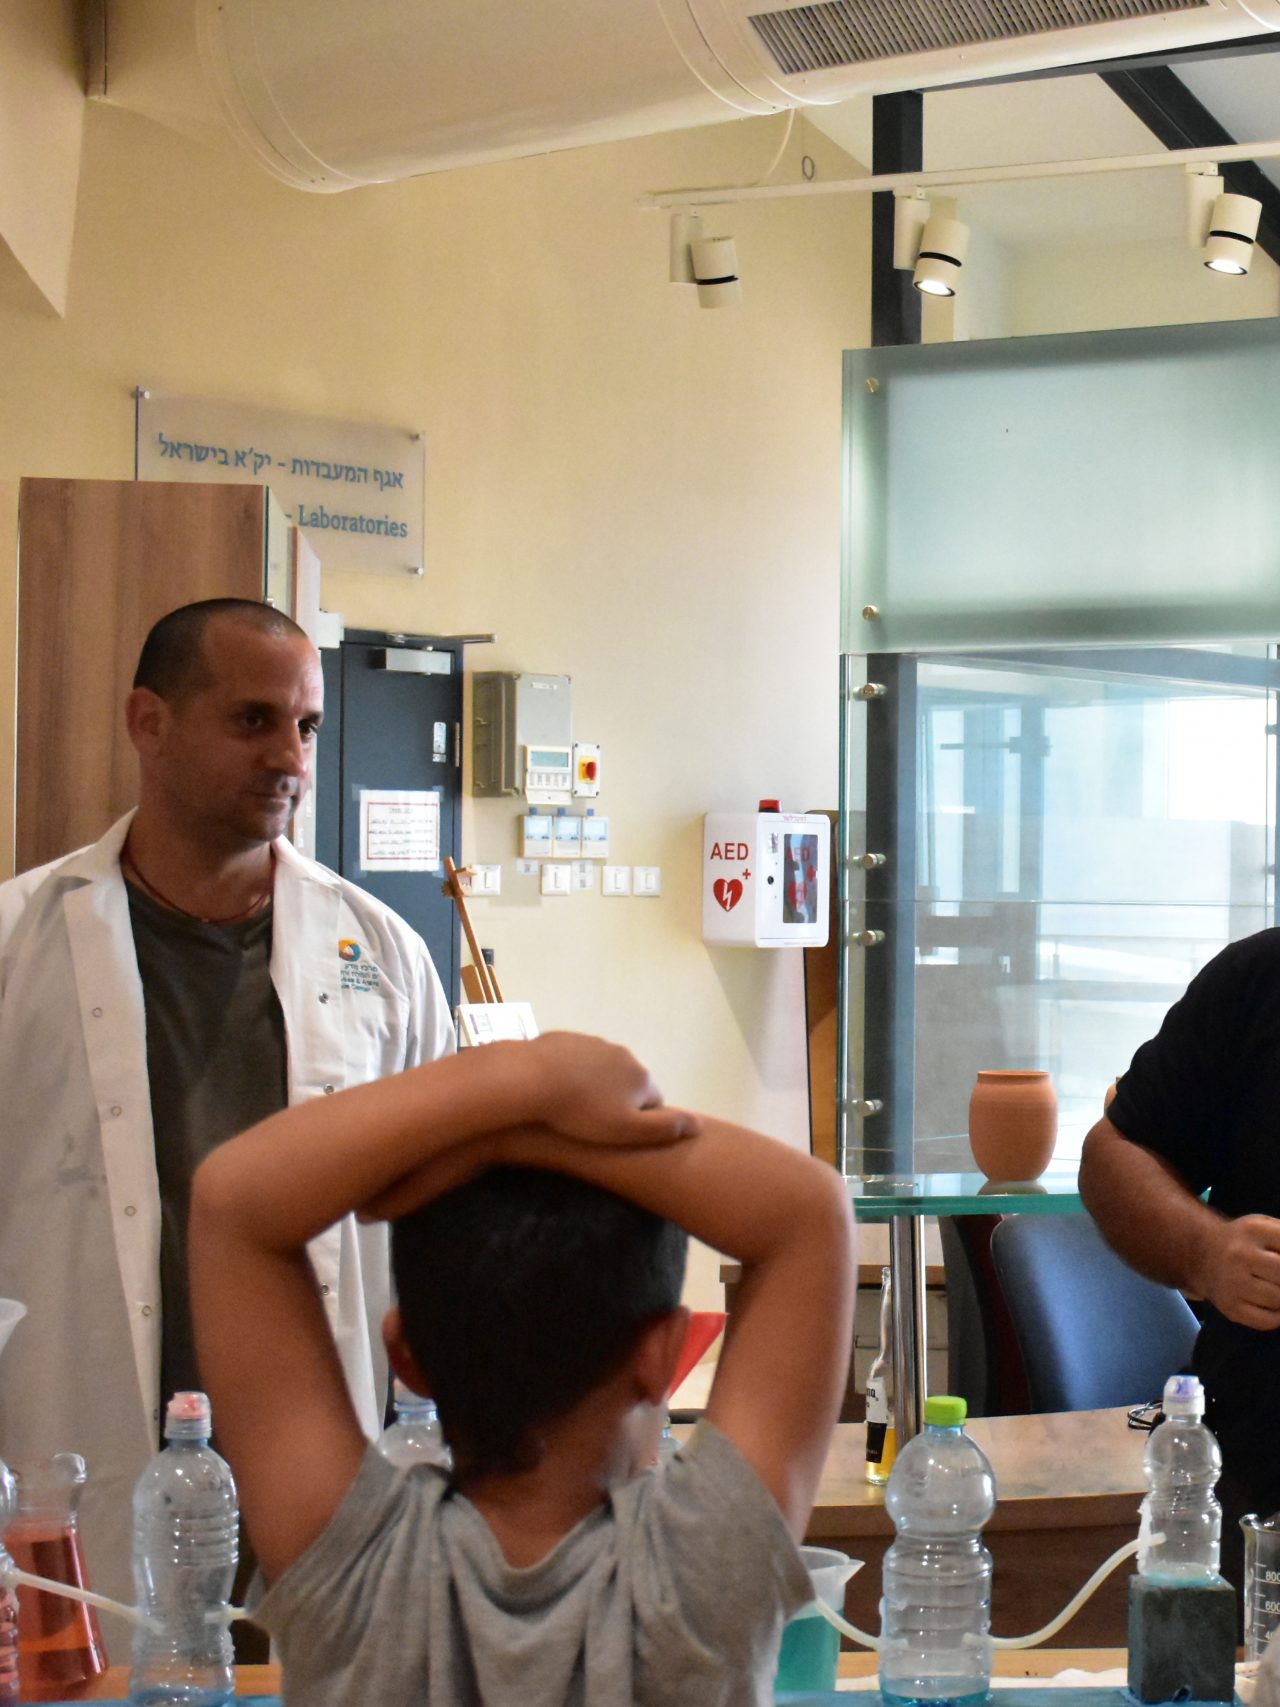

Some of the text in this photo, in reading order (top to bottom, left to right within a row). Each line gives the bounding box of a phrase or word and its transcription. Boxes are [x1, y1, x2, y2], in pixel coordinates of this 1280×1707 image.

[158, 432, 229, 465] בישראל
[291, 458, 368, 483] המעבדות
[373, 469, 404, 491] אגף
[298, 504, 407, 537] Laboratories
[710, 842, 749, 860] AED
